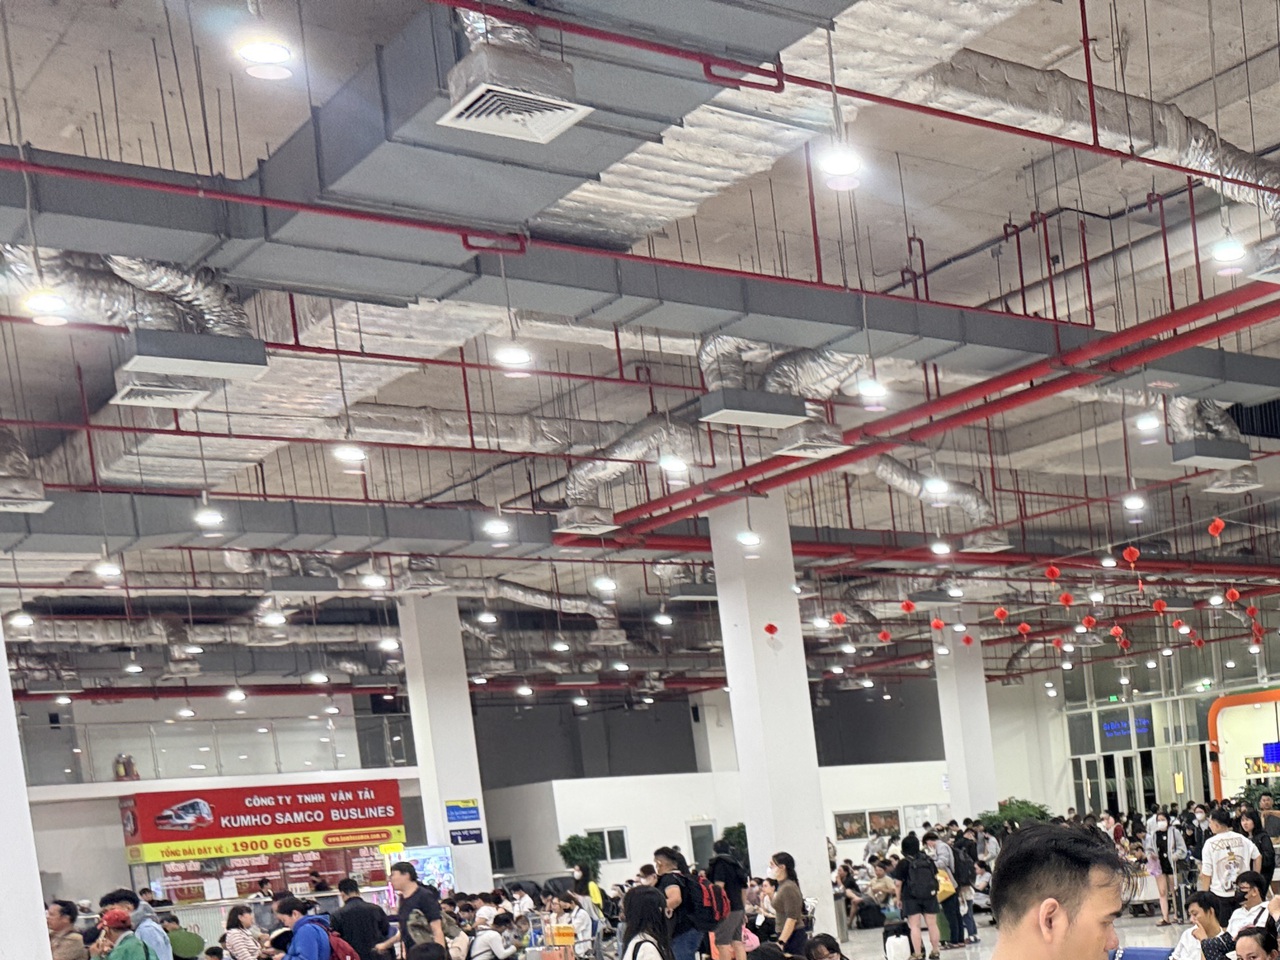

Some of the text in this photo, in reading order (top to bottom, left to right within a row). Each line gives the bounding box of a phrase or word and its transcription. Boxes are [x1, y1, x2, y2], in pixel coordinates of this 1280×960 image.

[244, 787, 375, 808] CÔNG TY TNHH VẬN TẢI
[220, 805, 395, 829] KUMHO SAMCO BUSLINES
[232, 839, 269, 853] 1900
[273, 836, 312, 849] 6065
